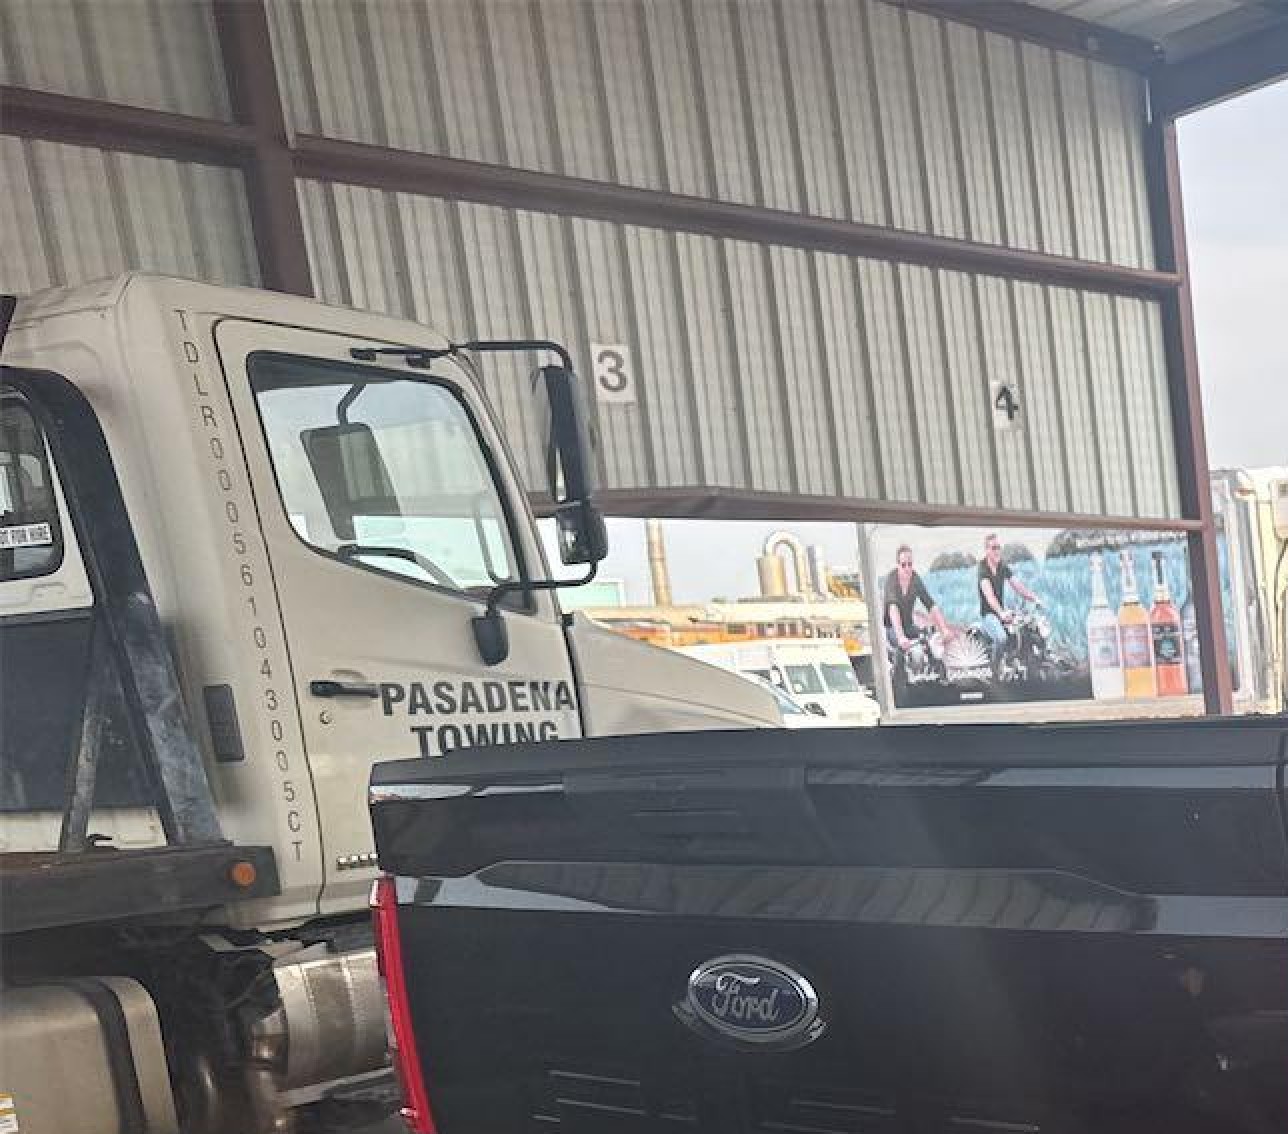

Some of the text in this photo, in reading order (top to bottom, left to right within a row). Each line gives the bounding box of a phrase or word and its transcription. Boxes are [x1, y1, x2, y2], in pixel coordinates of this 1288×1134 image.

[598, 349, 627, 393] 3
[995, 385, 1019, 421] 4
[379, 680, 575, 716] PASADENA
[410, 720, 559, 758] TOWING
[712, 972, 779, 1021] Ford
